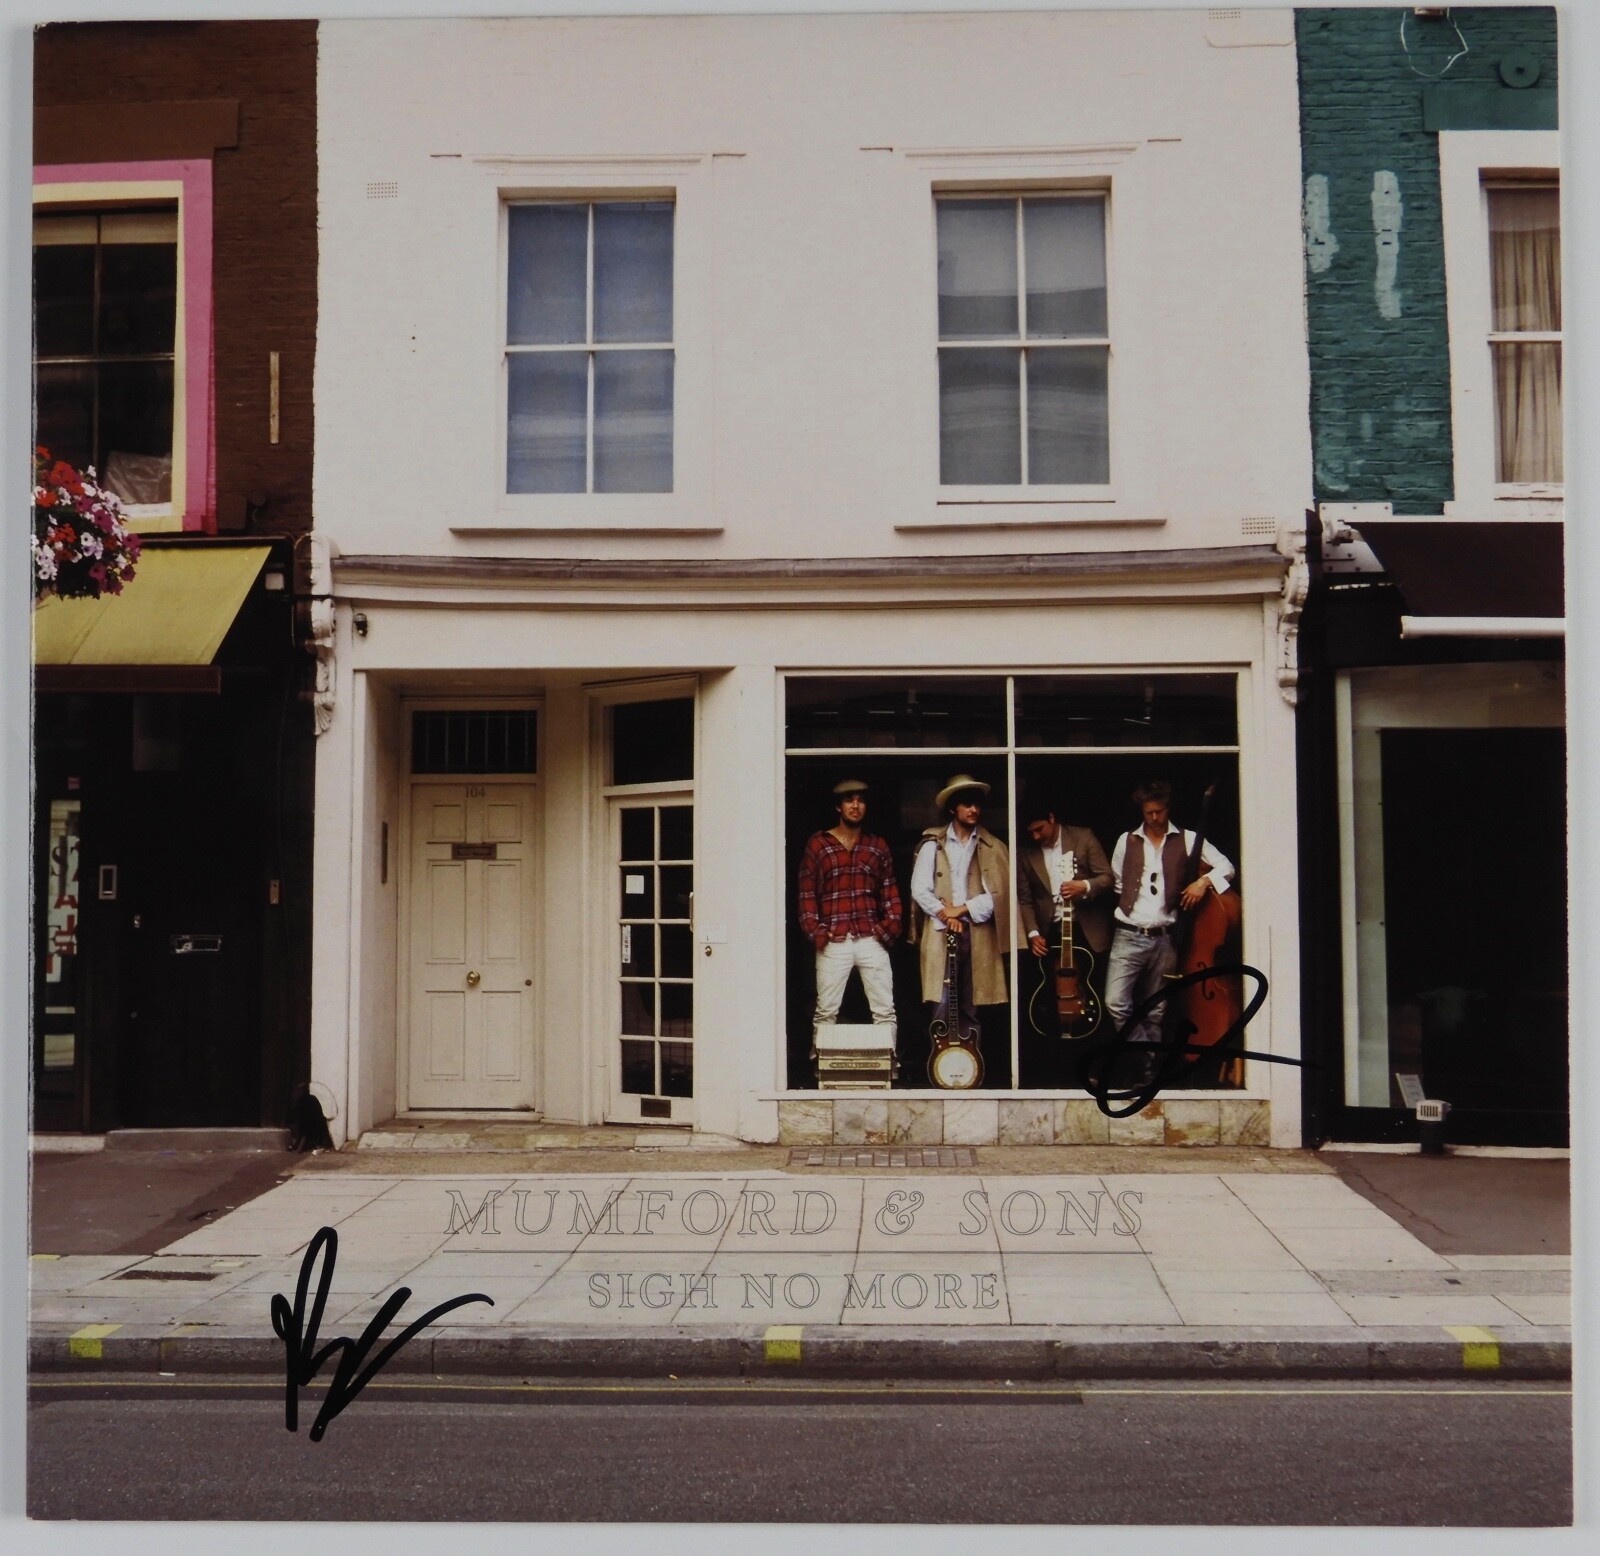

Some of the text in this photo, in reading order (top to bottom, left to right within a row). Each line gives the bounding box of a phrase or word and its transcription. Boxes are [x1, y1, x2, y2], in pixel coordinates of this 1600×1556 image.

[465, 785, 485, 798] 104
[443, 1189, 1143, 1236] MUMFORD & SONS
[588, 1272, 1000, 1310] SIGH NO MORE
